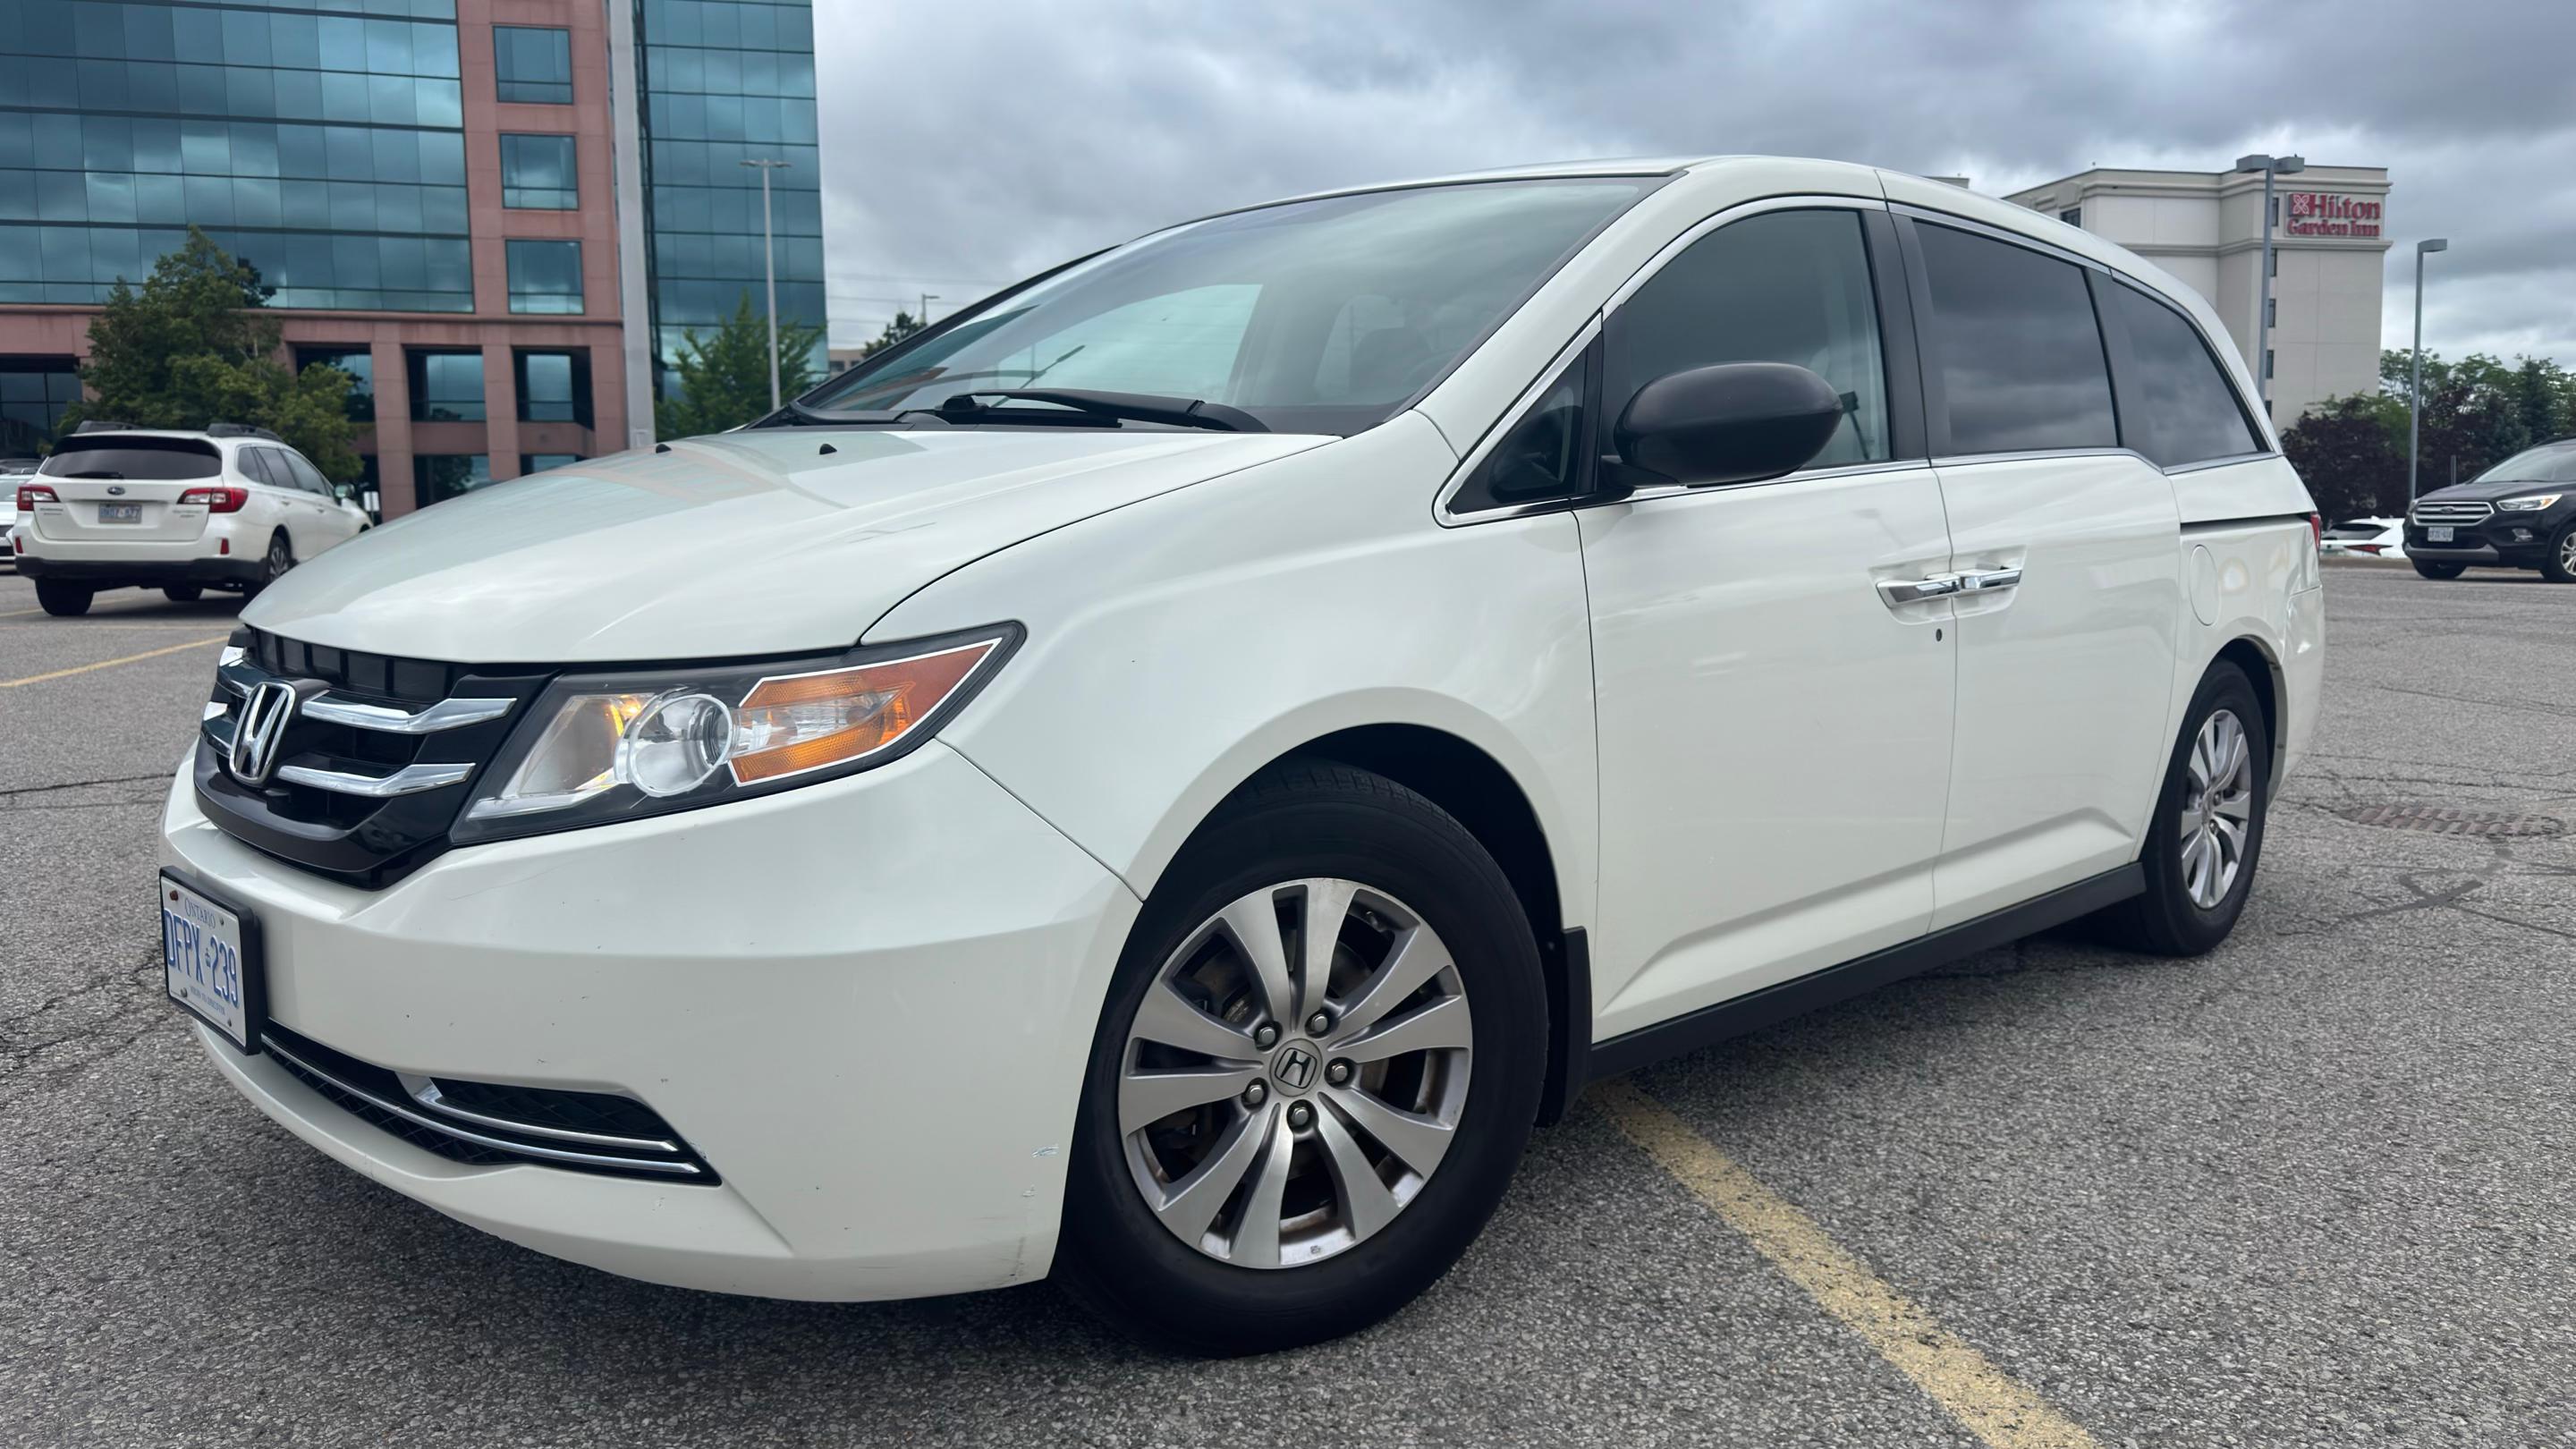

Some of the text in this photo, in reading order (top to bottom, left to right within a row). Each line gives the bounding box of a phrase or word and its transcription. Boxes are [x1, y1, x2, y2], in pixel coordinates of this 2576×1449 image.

[2309, 193, 2381, 220] Hilton
[2287, 218, 2380, 237] Garden Inn
[184, 897, 216, 929] ONTARIO
